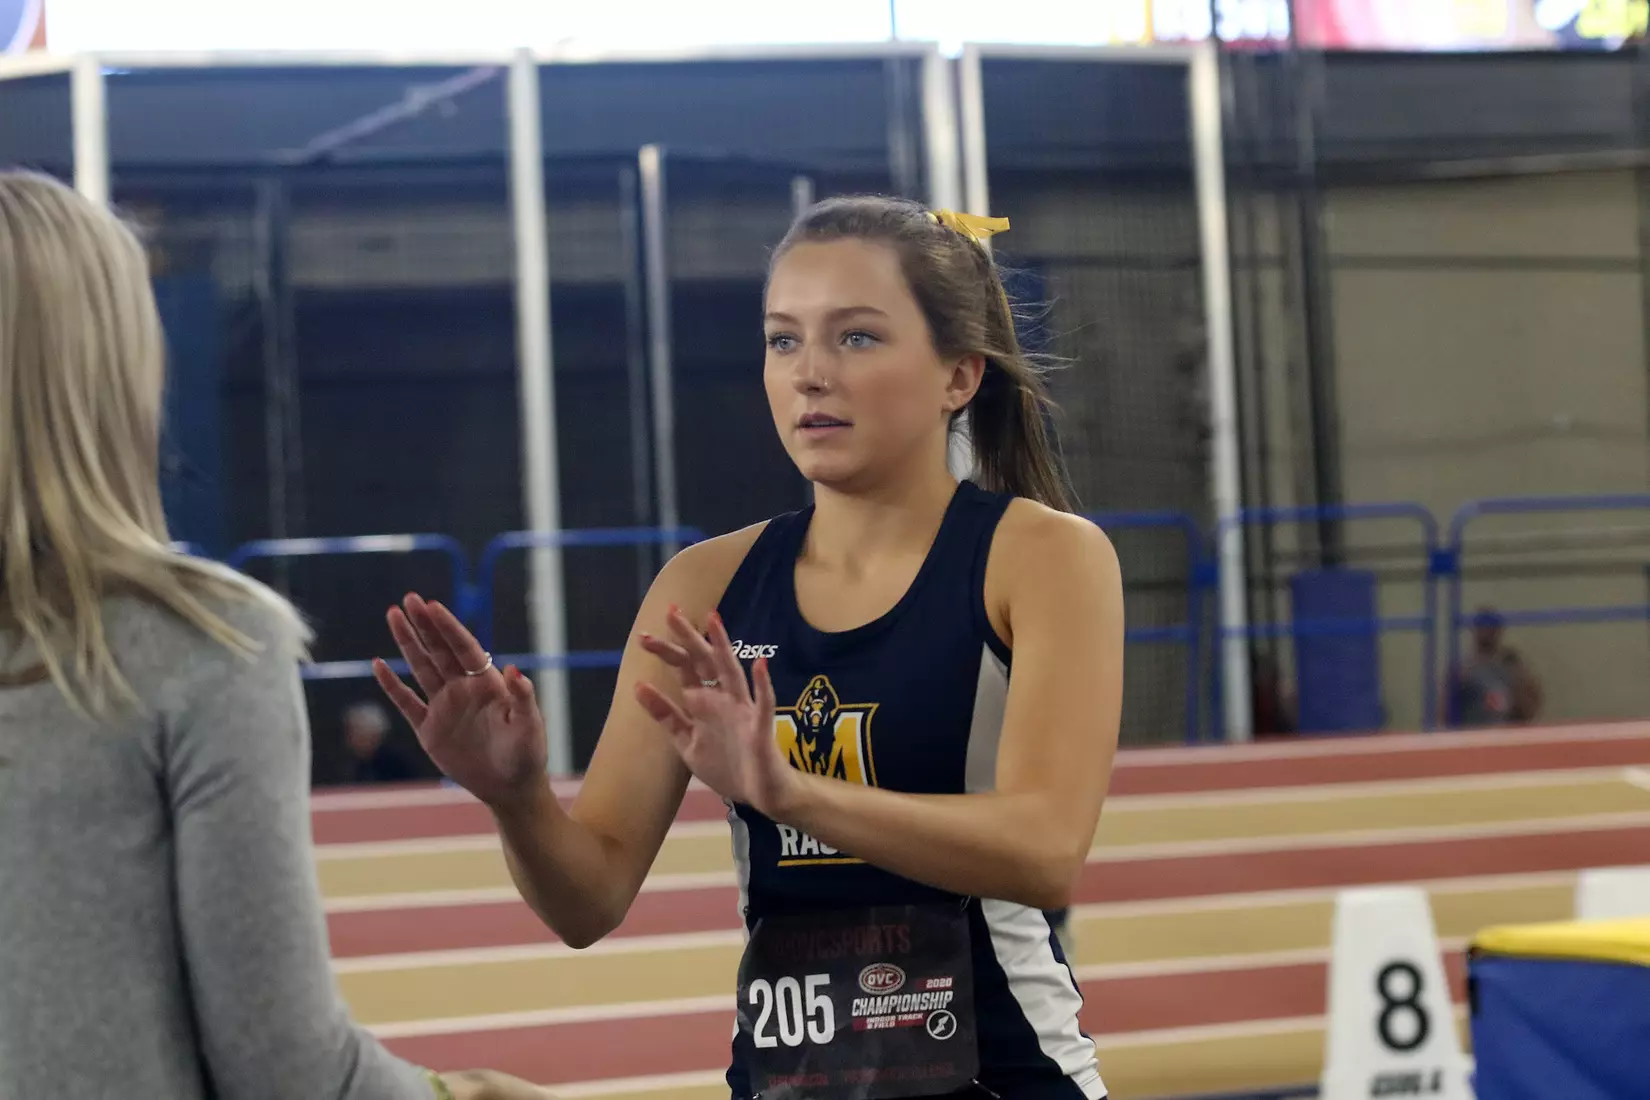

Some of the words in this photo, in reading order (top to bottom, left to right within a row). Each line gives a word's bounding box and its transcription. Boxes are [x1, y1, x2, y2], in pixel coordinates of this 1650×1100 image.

[738, 644, 779, 659] asics
[867, 972, 894, 986] OVC
[926, 977, 953, 989] 2020
[851, 990, 954, 1017] CHAMPIONSHIP
[1376, 960, 1431, 1052] 8
[749, 973, 836, 1049] 205
[866, 1015, 897, 1023] INDOOR
[898, 1013, 924, 1021] TRACK
[873, 1021, 896, 1029] FIELD
